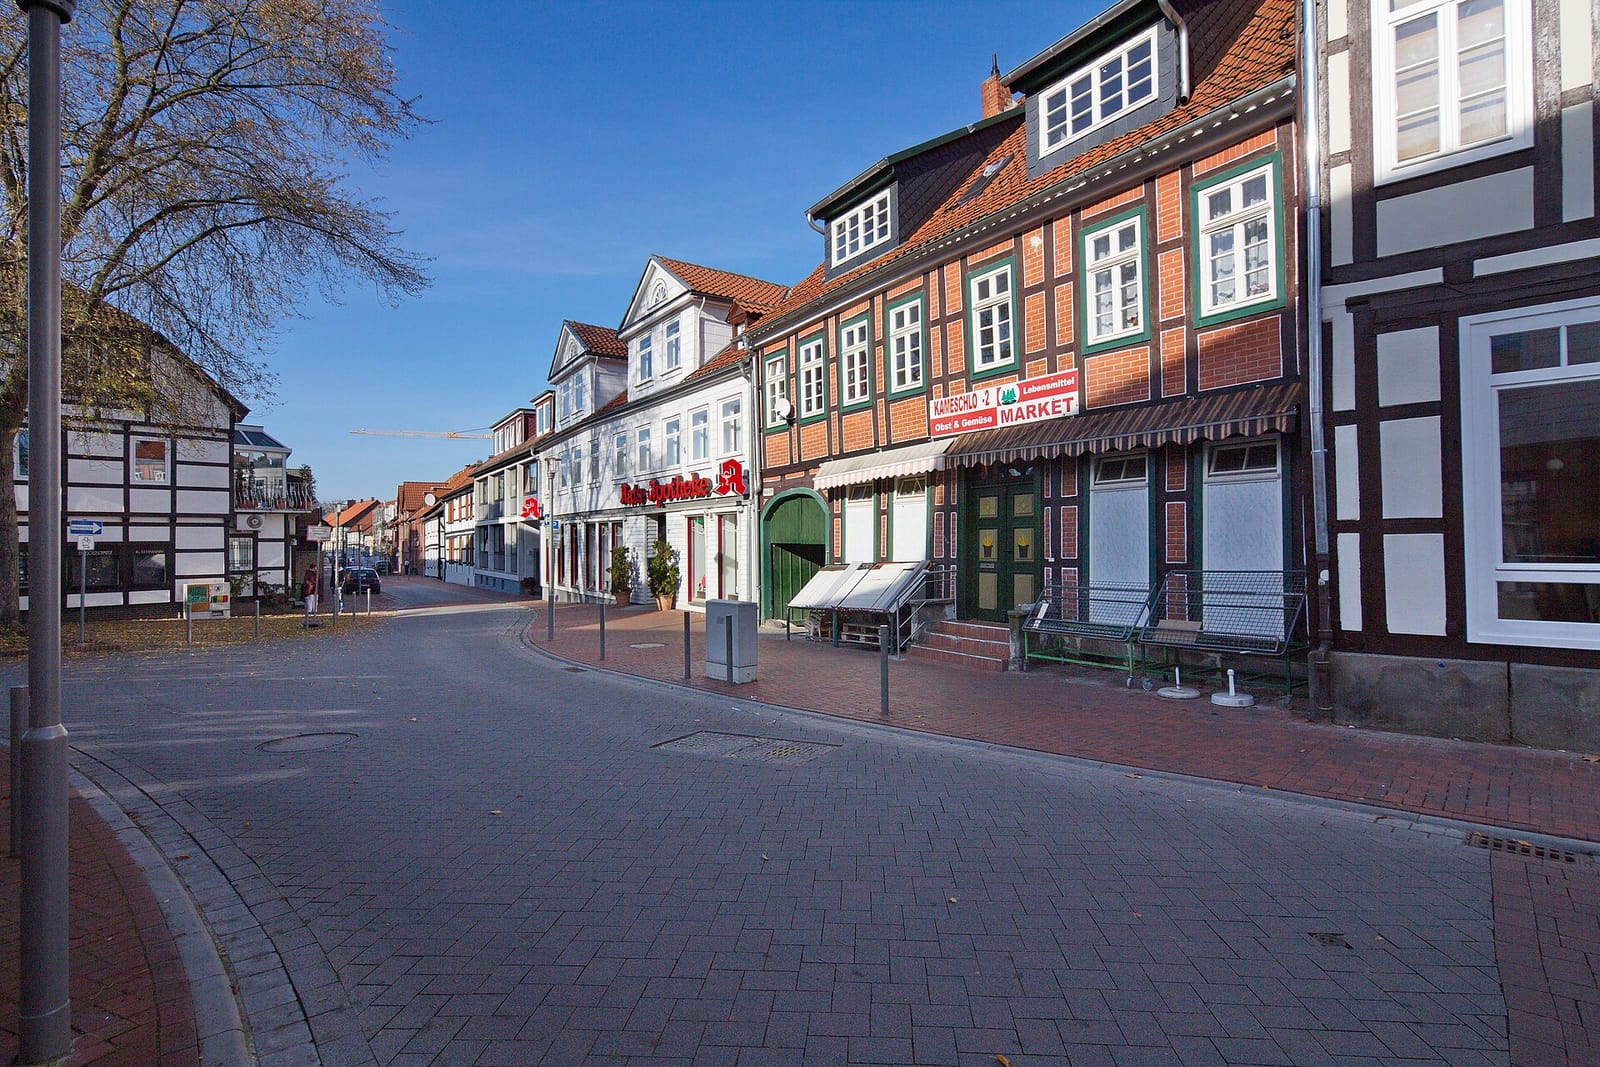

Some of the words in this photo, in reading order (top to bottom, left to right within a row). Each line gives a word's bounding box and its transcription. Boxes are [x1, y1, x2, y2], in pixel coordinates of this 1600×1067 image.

[1023, 376, 1075, 395] Lebensmittel
[1000, 396, 1074, 424] MARKET
[934, 421, 952, 432] Obst
[953, 420, 960, 429] &
[961, 415, 993, 428] Gemüse
